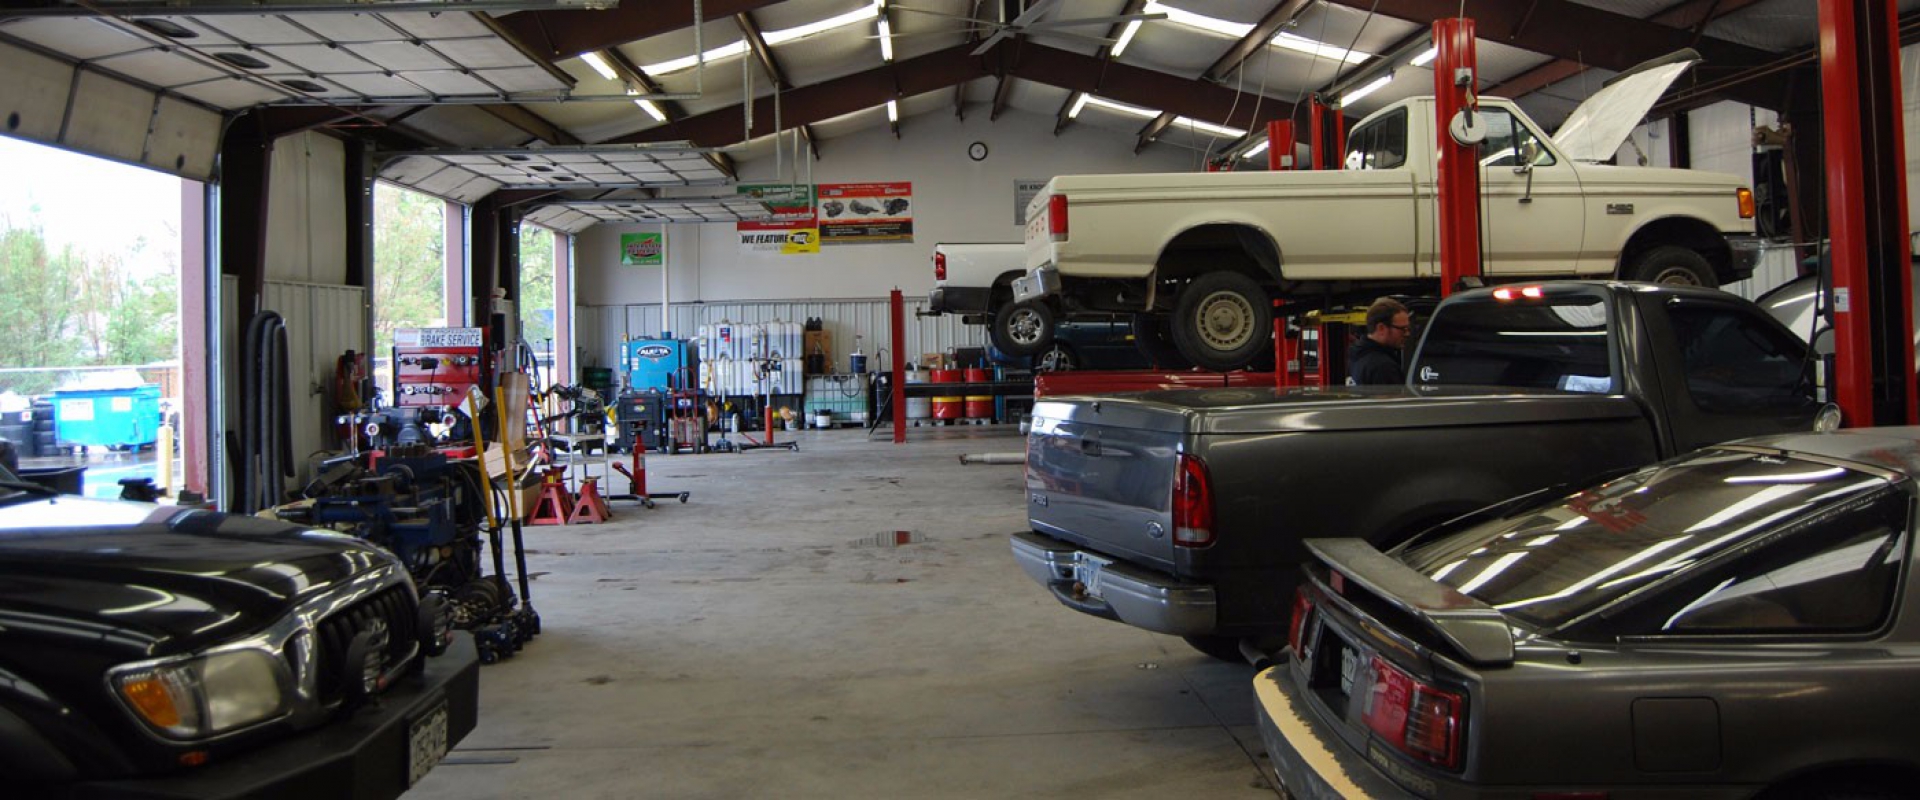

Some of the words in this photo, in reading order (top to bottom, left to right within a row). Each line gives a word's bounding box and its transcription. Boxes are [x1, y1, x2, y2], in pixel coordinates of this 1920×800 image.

[742, 234, 755, 244] WE
[756, 234, 789, 244] FEATURE
[420, 334, 447, 346] BRAKE
[448, 334, 480, 346] SERVICE
